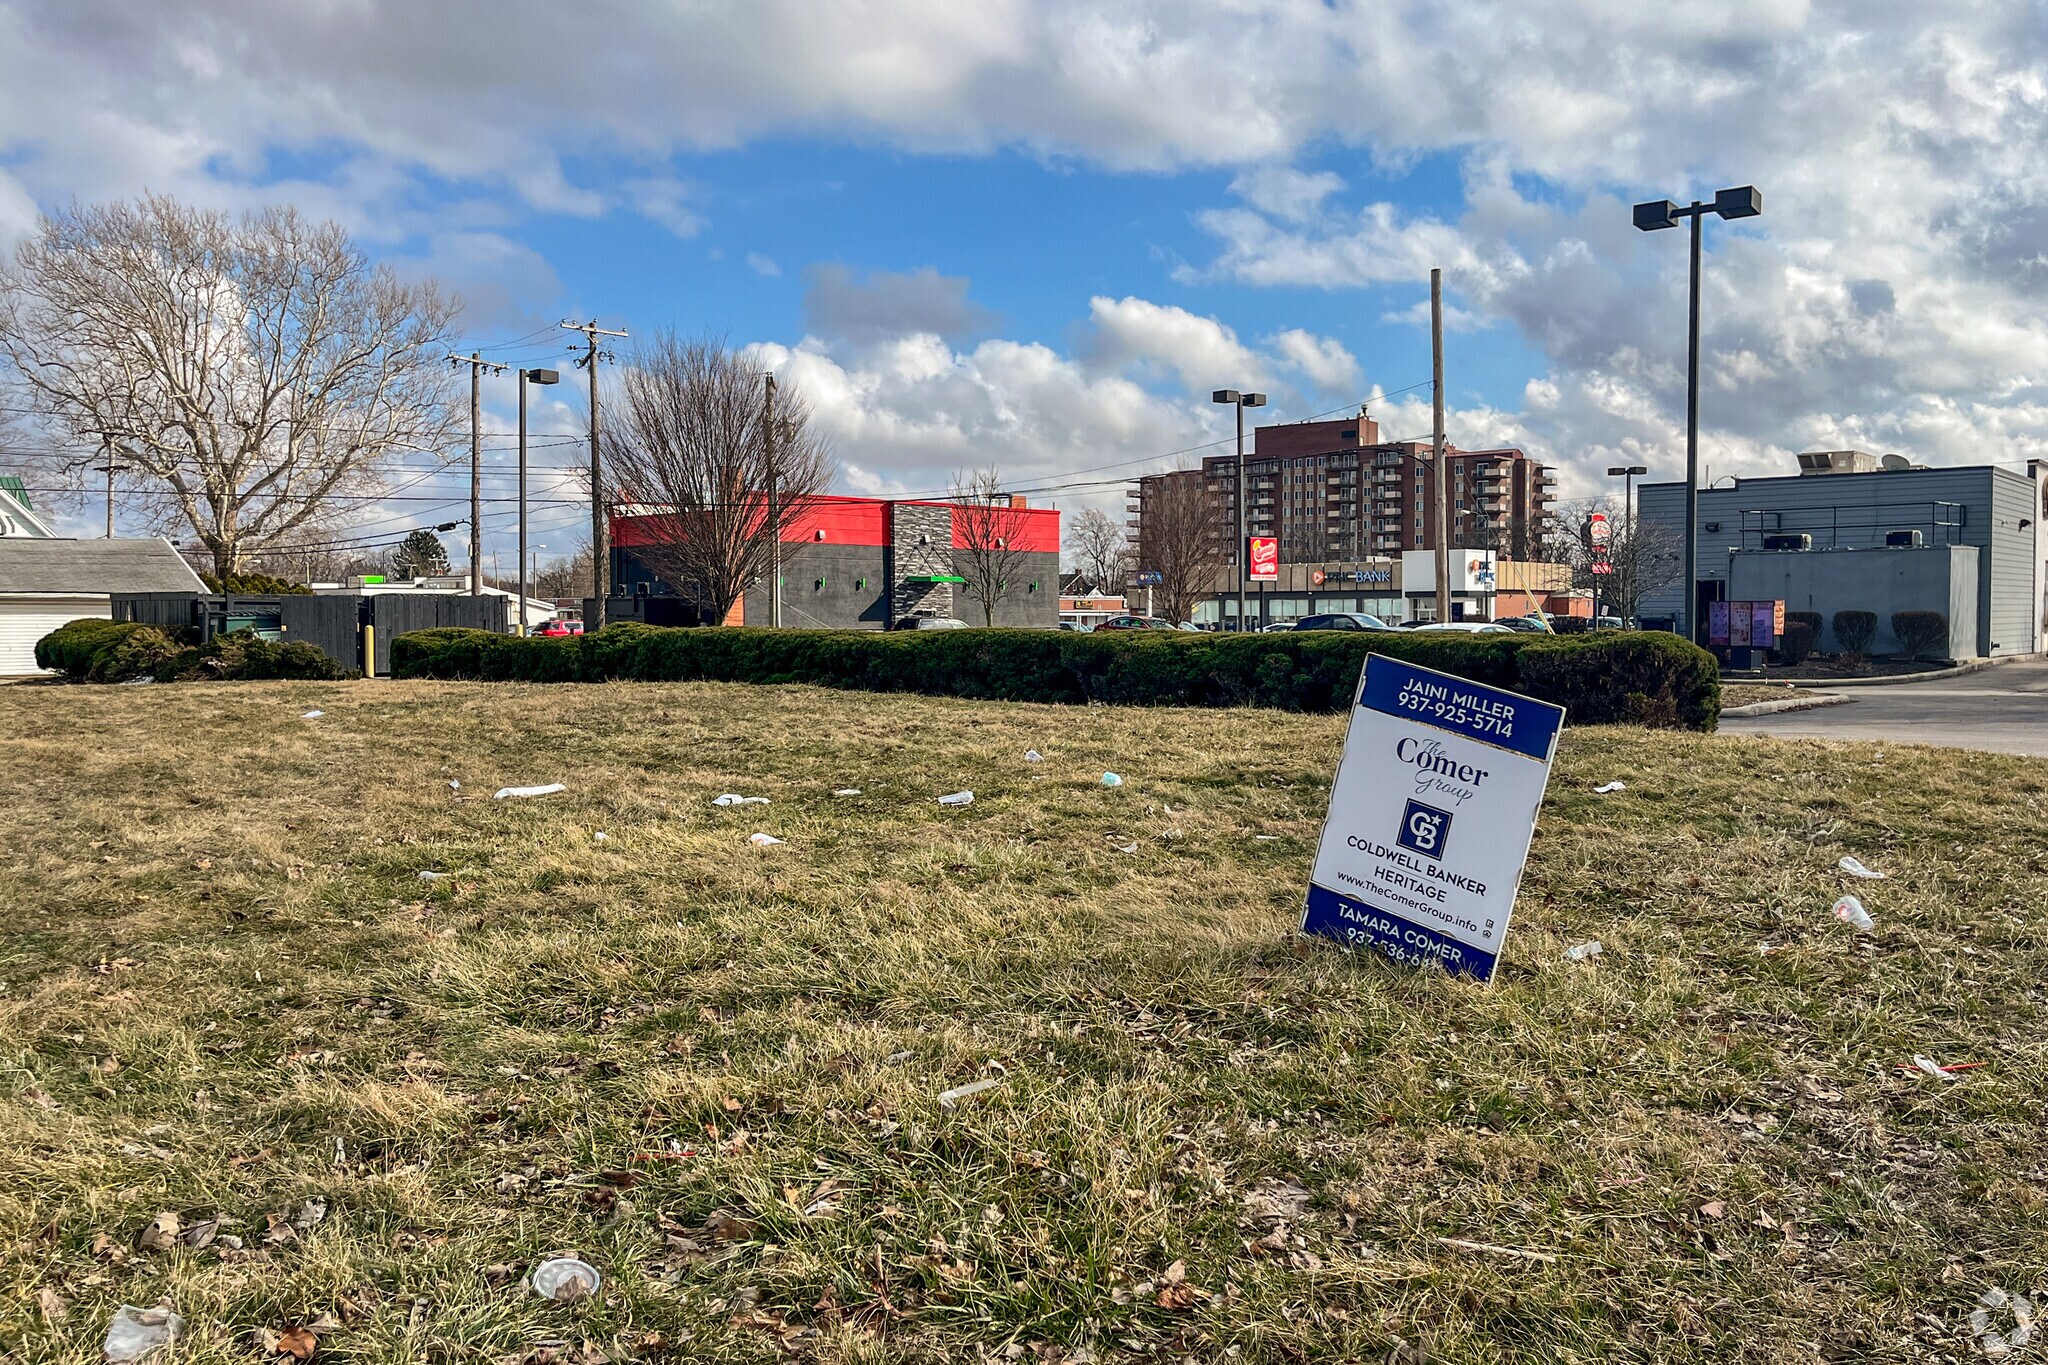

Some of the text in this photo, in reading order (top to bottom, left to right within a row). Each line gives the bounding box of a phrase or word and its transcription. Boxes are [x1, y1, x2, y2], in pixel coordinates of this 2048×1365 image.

[1355, 570, 1390, 583] BANK
[1398, 691, 1513, 738] 937-925-5714
[1403, 679, 1515, 721] JAINI MILLER
[1396, 737, 1489, 787] Comer
[1422, 738, 1447, 757] The
[1414, 768, 1474, 807] Group
[1409, 811, 1438, 850] CB
[1347, 835, 1487, 897] COLDWELL BANKER
[1374, 866, 1447, 903] HERITAGE
[1337, 871, 1477, 932] www.TheComerGroup.info
[1338, 903, 1462, 963] TAMARA COMER
